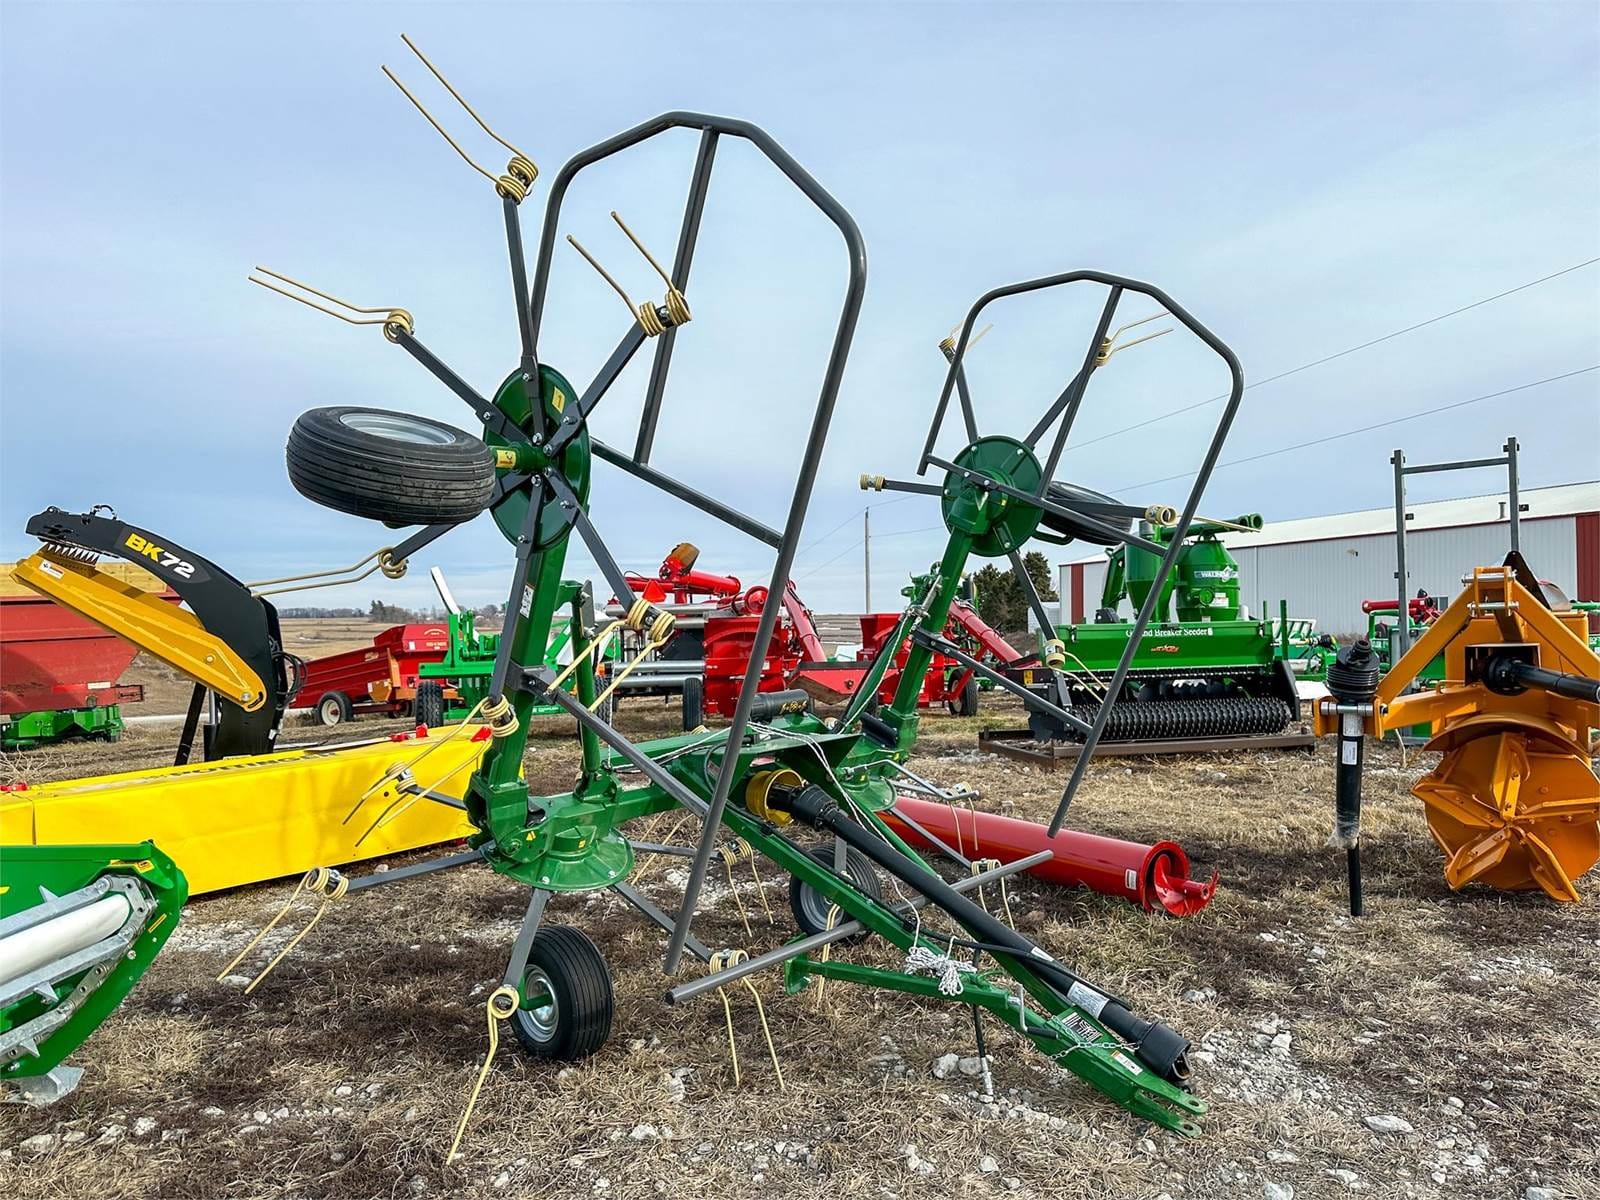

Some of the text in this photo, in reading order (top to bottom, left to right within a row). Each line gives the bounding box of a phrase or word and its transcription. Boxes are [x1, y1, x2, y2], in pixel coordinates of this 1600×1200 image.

[125, 533, 195, 579] BK72
[1154, 628, 1183, 637] Breaker
[1184, 627, 1207, 636] Seeder
